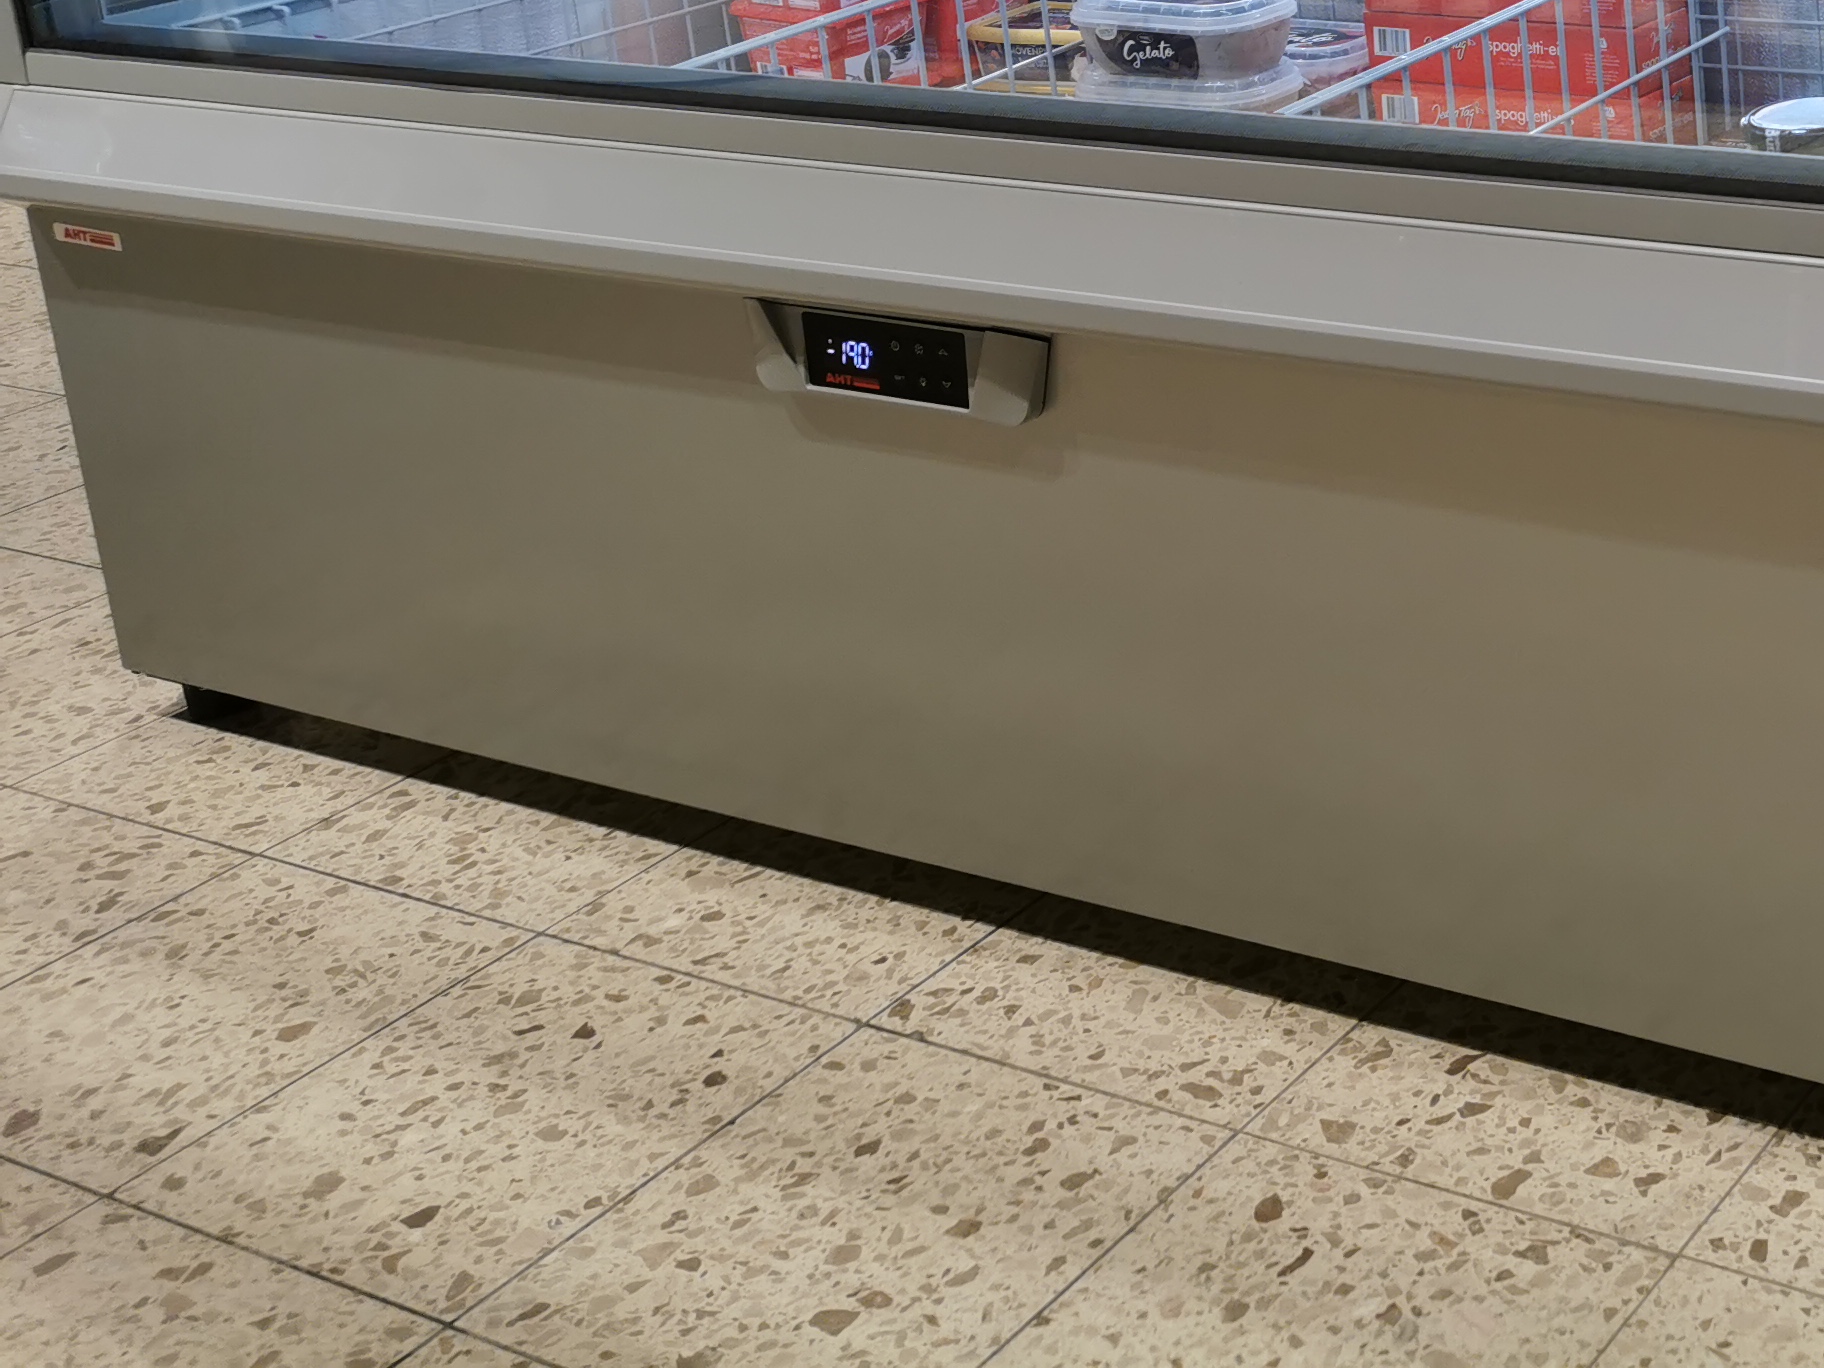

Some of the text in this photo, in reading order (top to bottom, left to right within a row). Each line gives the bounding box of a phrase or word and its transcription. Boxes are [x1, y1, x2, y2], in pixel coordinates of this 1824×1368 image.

[1122, 39, 1175, 68] Gelato
[64, 227, 88, 242] AHT
[826, 373, 852, 385] AHT
